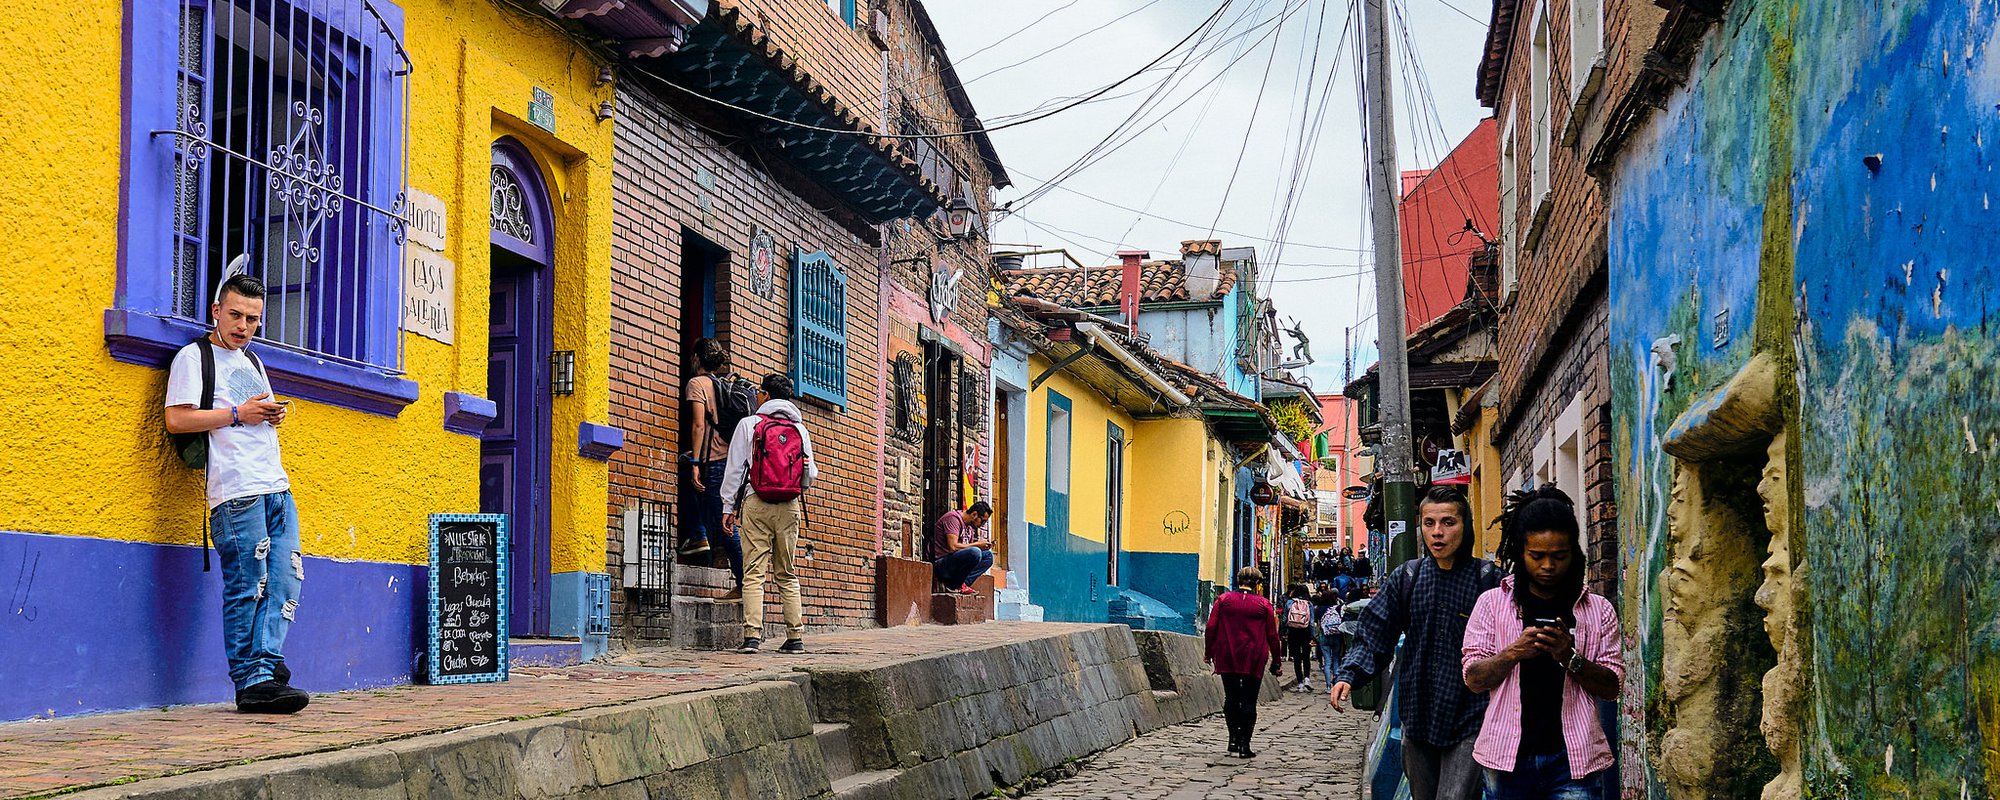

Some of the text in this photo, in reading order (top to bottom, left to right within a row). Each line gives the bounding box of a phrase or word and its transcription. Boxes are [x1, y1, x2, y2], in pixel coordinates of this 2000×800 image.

[408, 200, 444, 239] HOTEL
[413, 257, 444, 294] CASA
[454, 566, 488, 588] Bebidas
